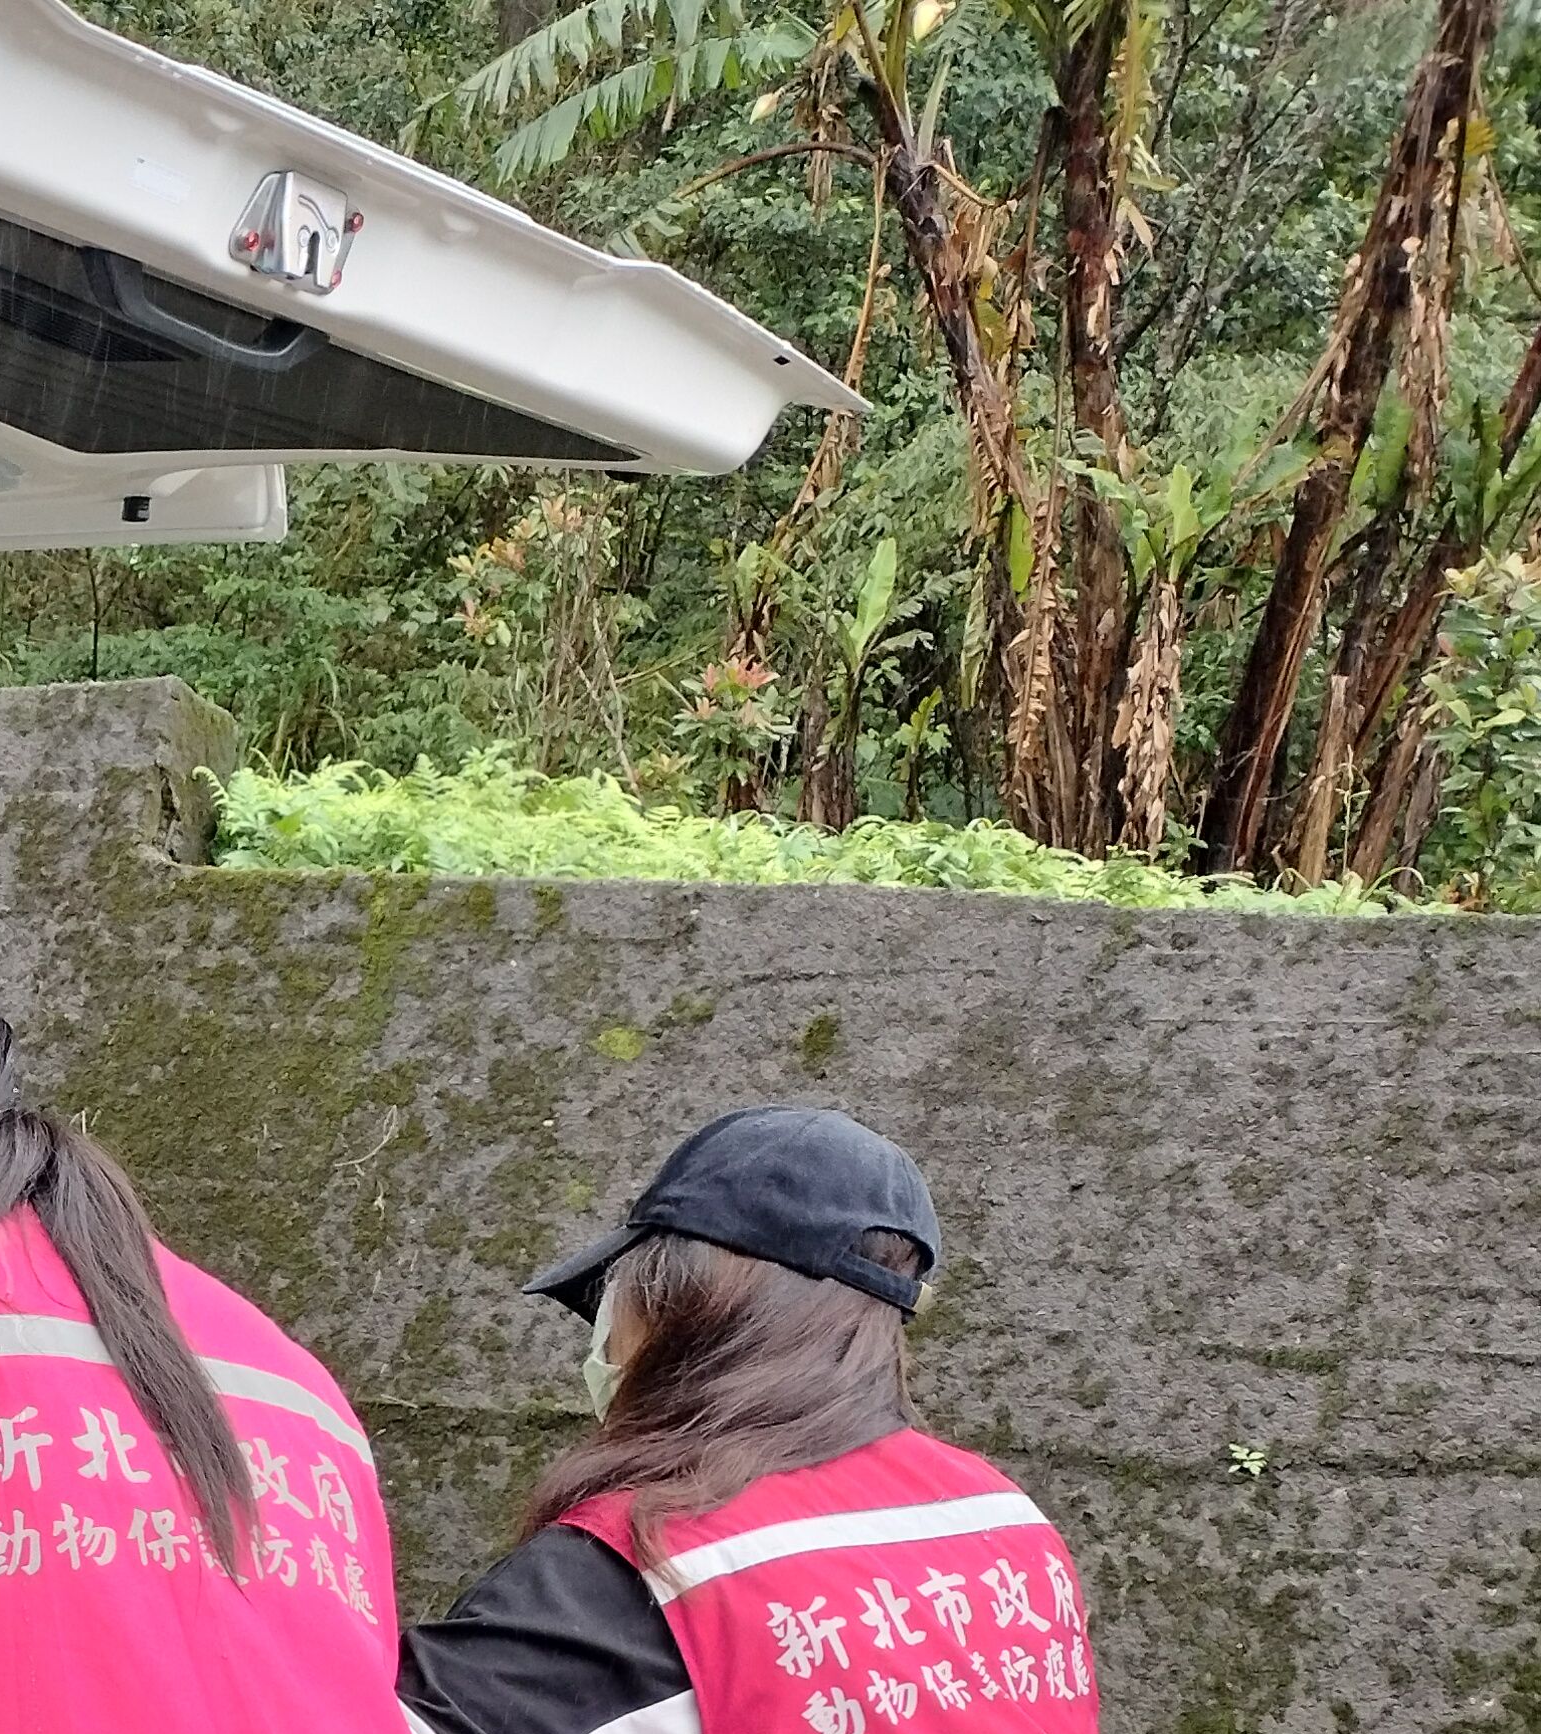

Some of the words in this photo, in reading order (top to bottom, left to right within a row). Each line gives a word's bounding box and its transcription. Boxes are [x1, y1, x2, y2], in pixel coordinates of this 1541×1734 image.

[765, 1551, 1088, 1679] 新北市政府
